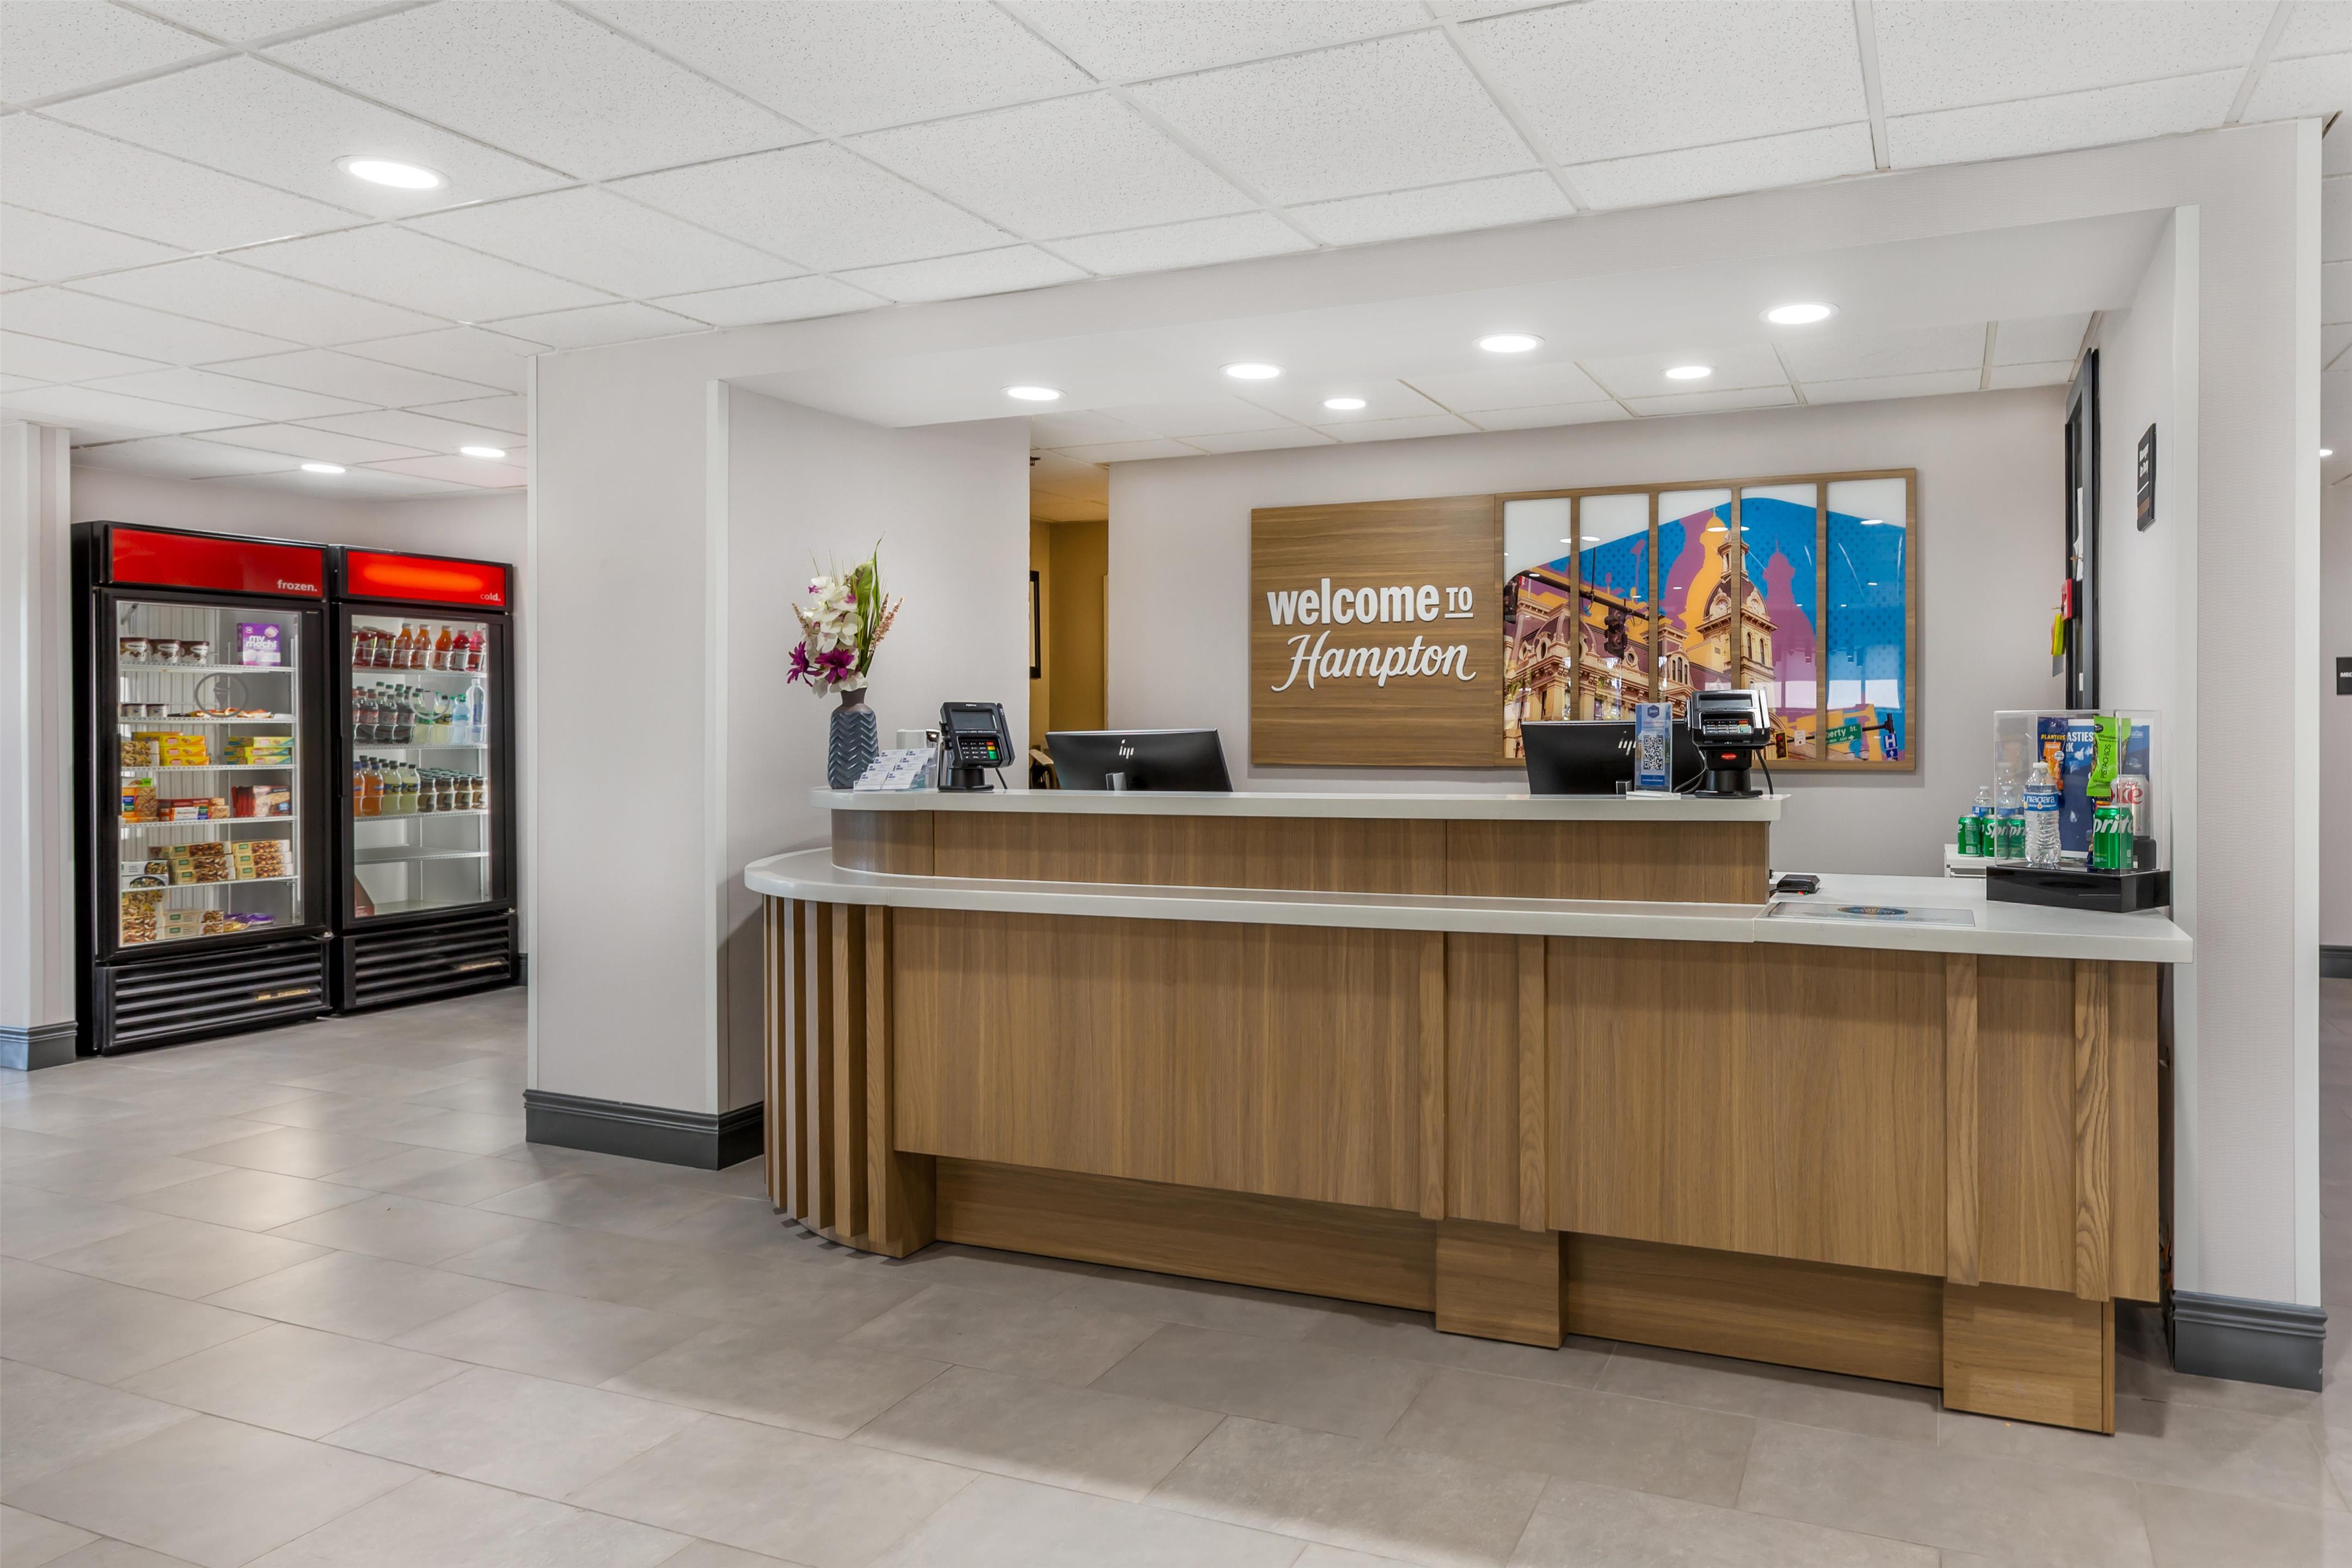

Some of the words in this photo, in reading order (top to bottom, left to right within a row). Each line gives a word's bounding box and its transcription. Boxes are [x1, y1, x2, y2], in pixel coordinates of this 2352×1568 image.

[277, 579, 317, 592] frozen.
[480, 592, 501, 602] cold.
[1266, 578, 1440, 625] welcome
[1445, 586, 1473, 612] TO
[1271, 630, 1477, 691] Hampton
[2100, 744, 2111, 779] PISTACHIOS
[2026, 795, 2056, 804] niagara
